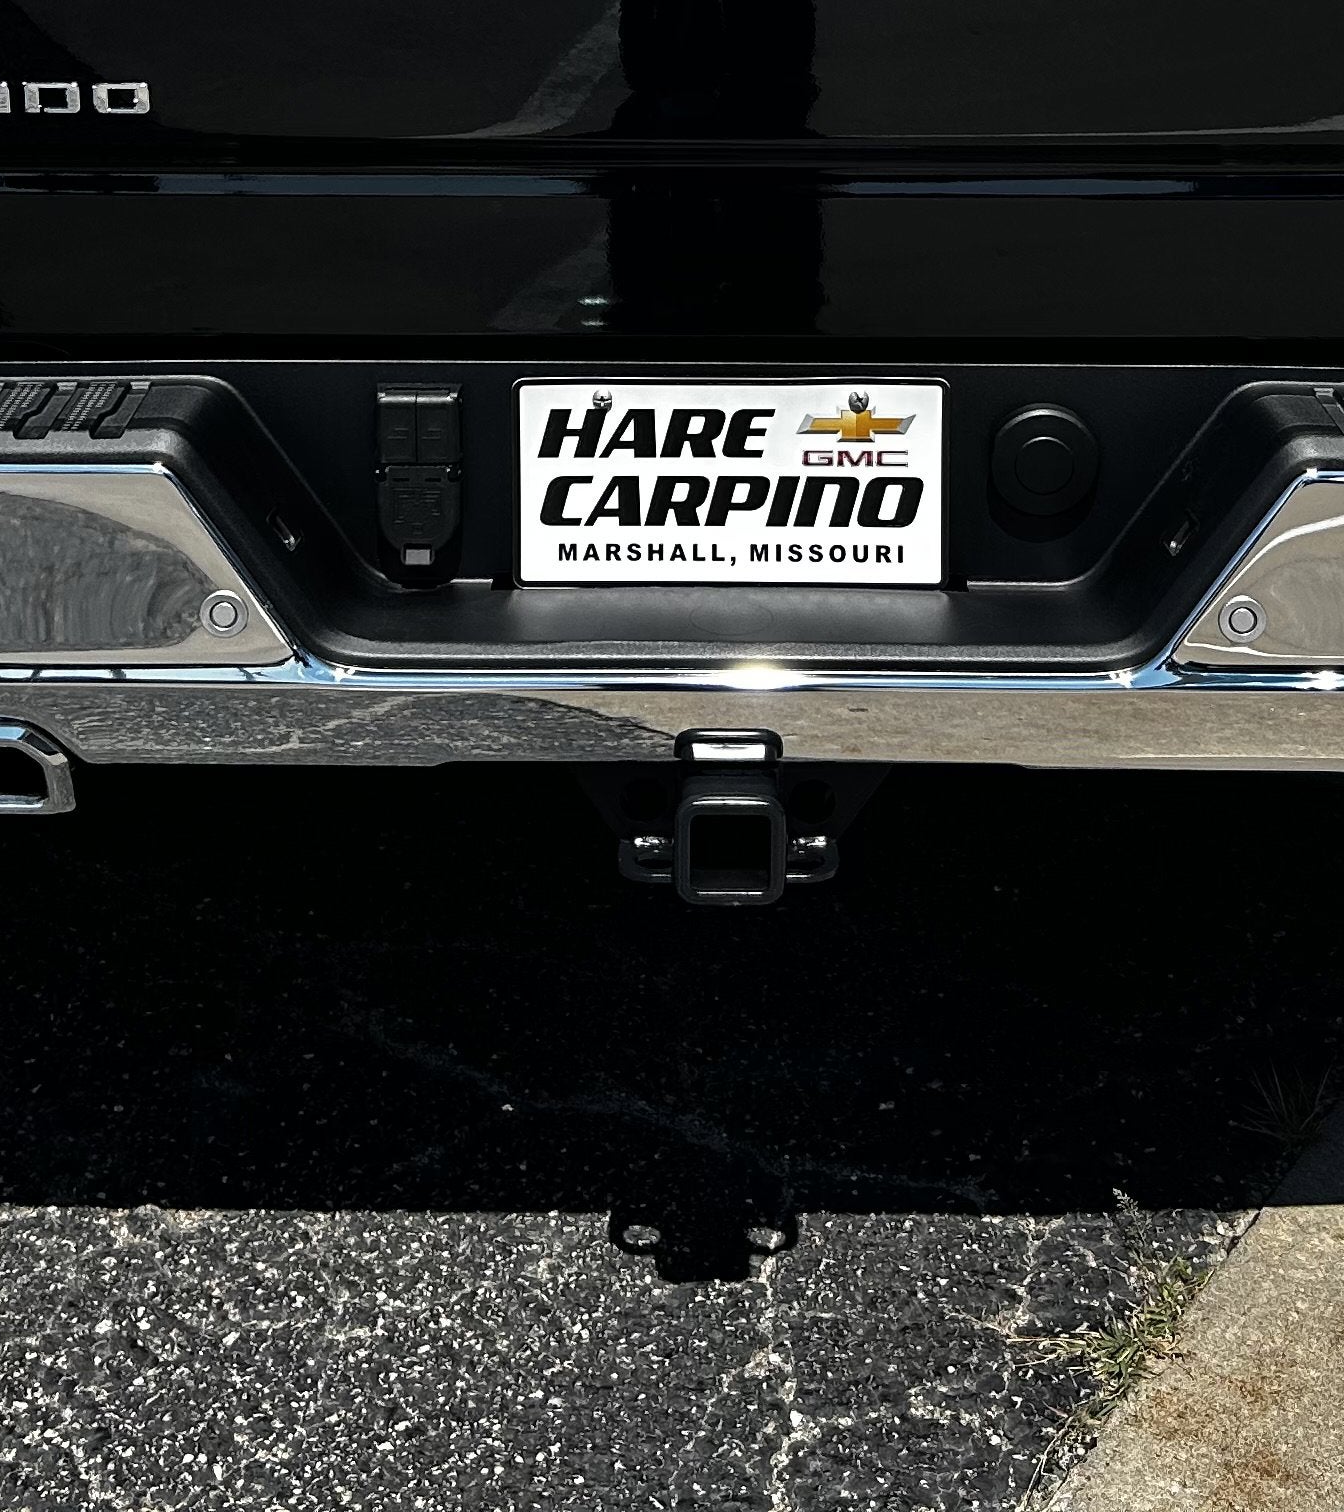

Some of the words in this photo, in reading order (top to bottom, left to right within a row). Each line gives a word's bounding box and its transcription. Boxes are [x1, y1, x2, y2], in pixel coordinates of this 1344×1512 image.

[537, 408, 776, 459] HARE
[801, 449, 910, 468] GMC
[539, 475, 925, 528] CARPINO
[558, 543, 737, 566] MARSHALL,
[749, 544, 905, 564] MISSOURI
